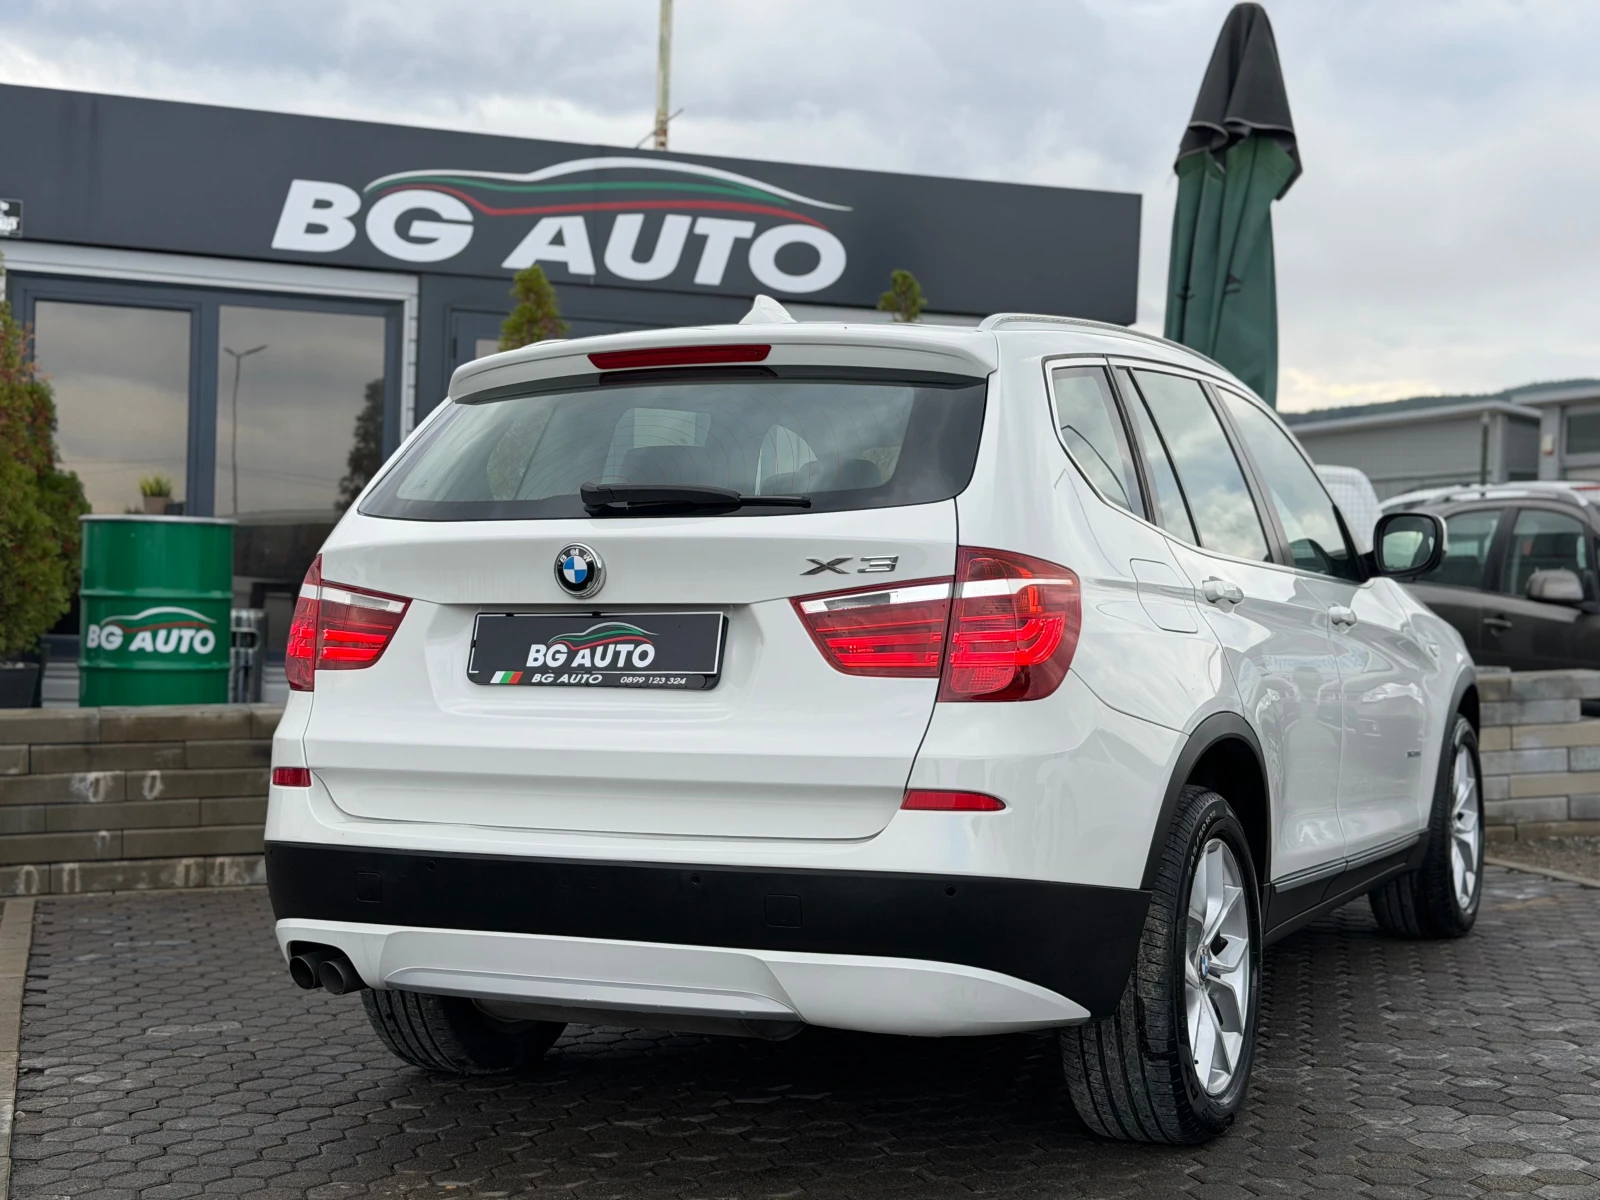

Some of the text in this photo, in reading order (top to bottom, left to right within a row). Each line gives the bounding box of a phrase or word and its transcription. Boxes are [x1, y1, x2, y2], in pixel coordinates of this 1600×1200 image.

[271, 179, 847, 293] BG AUTO
[560, 548, 593, 563] BMW
[800, 555, 899, 576] X3
[86, 624, 216, 654] BG AUTO
[526, 644, 656, 668] BG AUTO
[531, 673, 555, 684] BG
[557, 673, 603, 684] AUTO
[620, 676, 646, 684] 0899
[667, 677, 687, 685] 324
